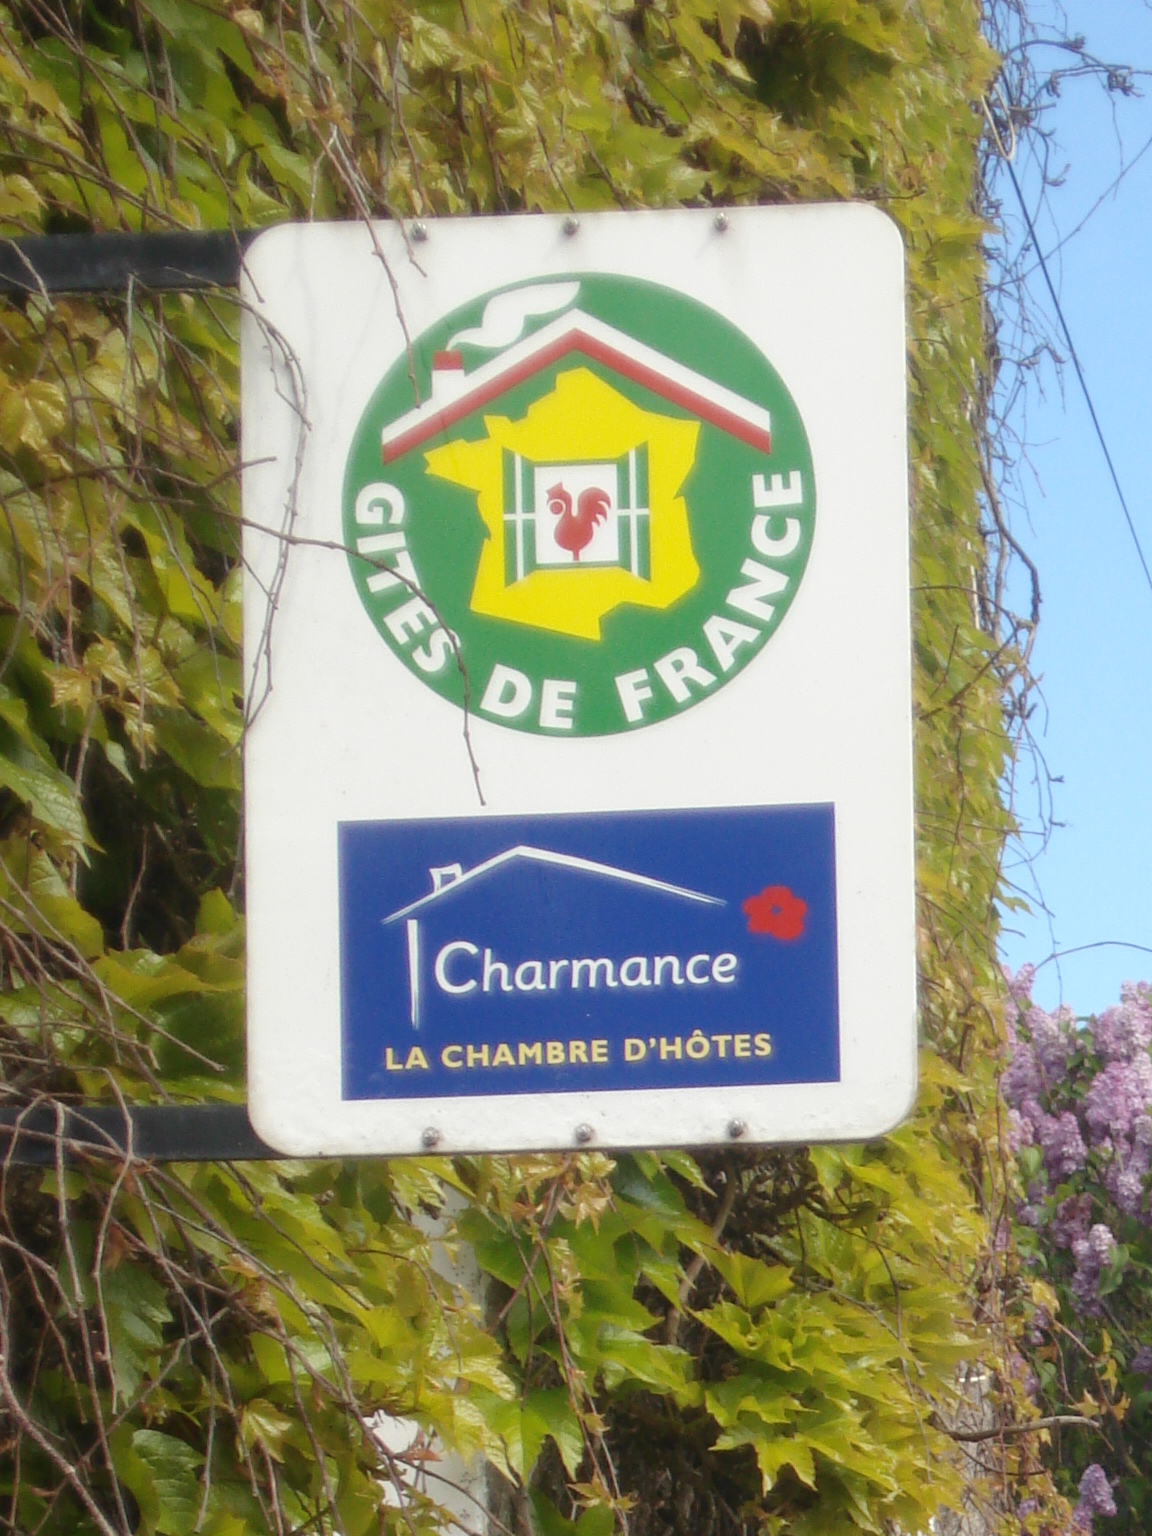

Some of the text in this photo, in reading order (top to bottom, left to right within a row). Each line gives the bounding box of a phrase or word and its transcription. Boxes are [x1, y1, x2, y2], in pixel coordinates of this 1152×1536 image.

[355, 470, 803, 729] GITES DE FRANCE
[434, 940, 738, 994] Charmance
[385, 1030, 773, 1070] LA CHAMBRE D'HÔTES
